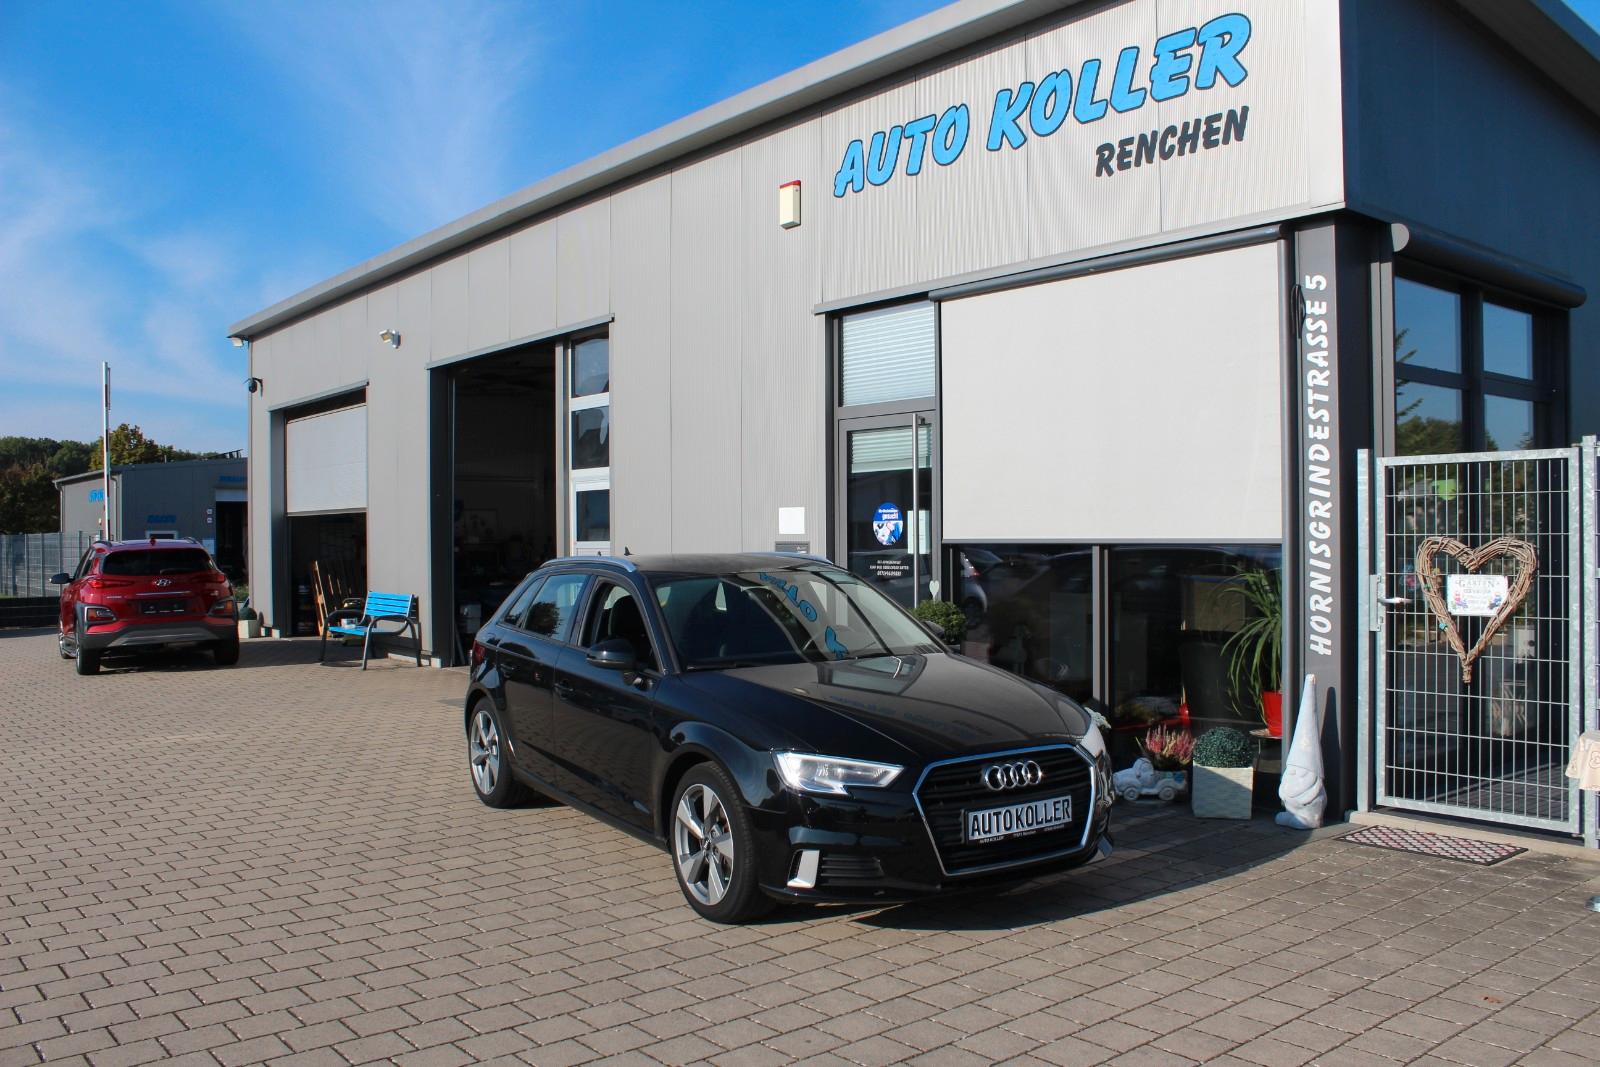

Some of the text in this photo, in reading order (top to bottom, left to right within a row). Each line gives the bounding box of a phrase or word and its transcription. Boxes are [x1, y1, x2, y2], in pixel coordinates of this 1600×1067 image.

[833, 13, 1252, 198] AUTO KOLLER
[1095, 105, 1250, 178] RENCHEN
[1305, 274, 1333, 655] HORNISGRINDESTRASSE 5
